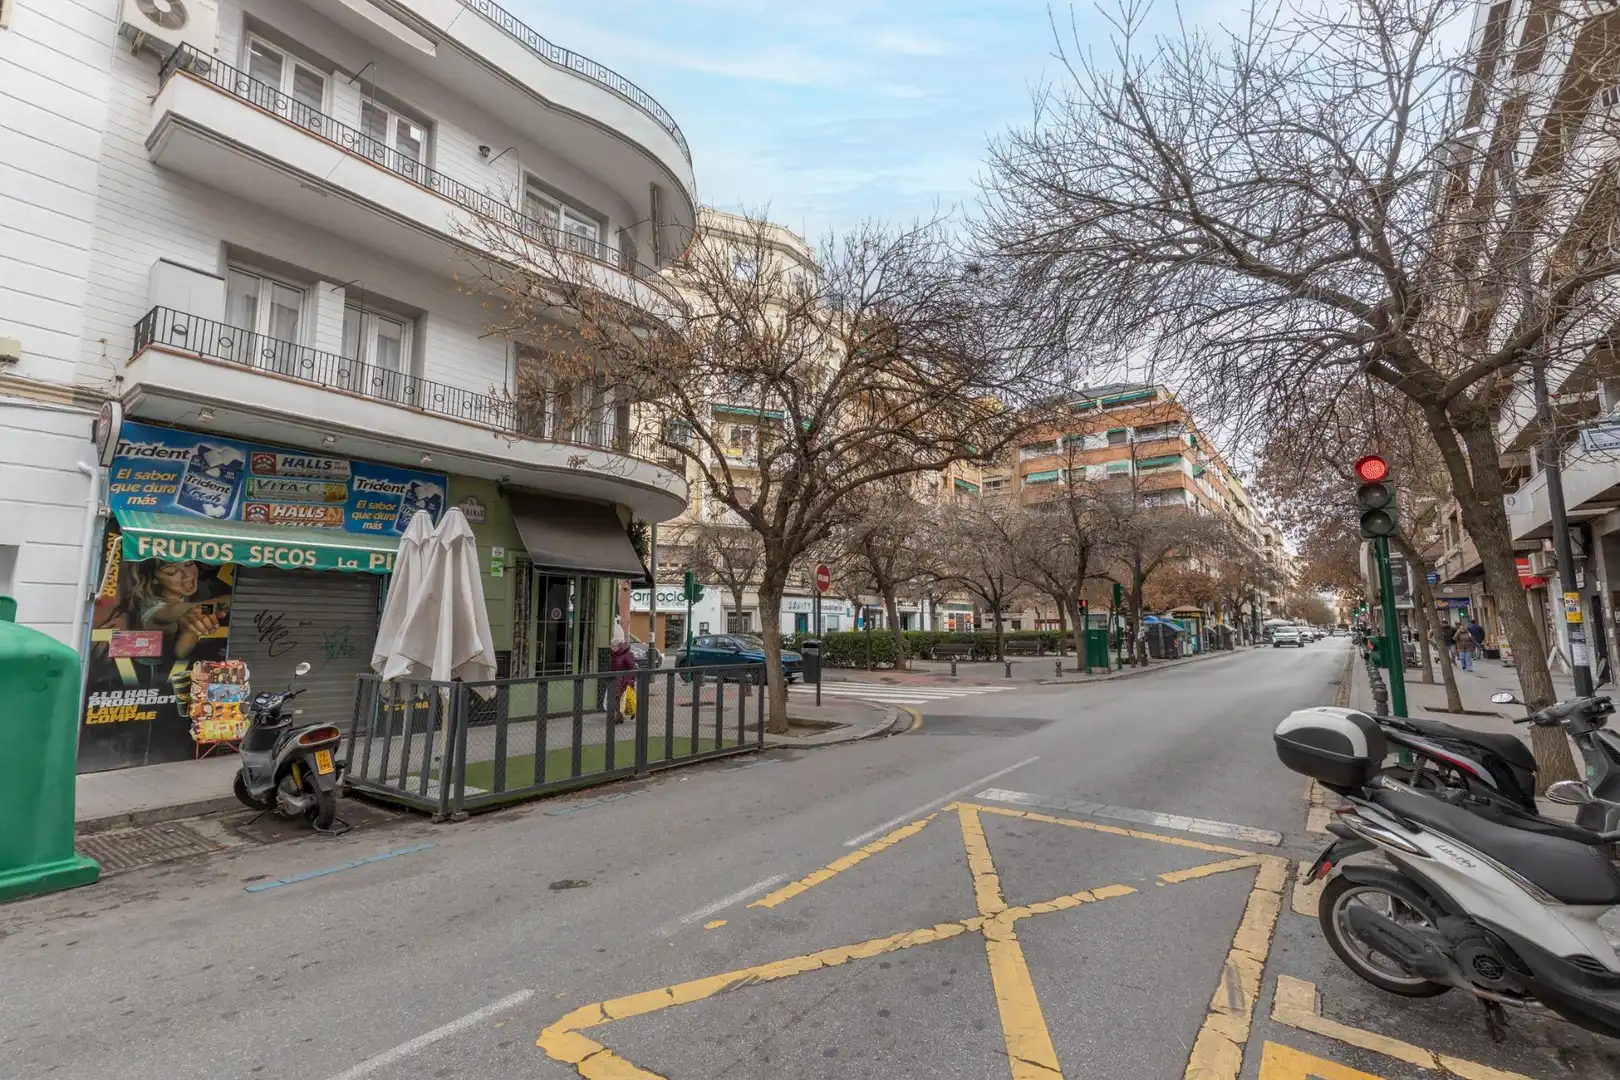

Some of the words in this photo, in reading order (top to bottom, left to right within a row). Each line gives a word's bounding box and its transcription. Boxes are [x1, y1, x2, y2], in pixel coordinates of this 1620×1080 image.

[116, 441, 190, 460] Trident
[281, 457, 332, 470] HALLS
[116, 468, 132, 480] El
[134, 470, 177, 481] sabor
[110, 483, 140, 494] que
[143, 482, 177, 493] dura
[186, 474, 231, 494] Trident
[356, 479, 406, 494] Trident
[127, 494, 158, 505] más
[356, 500, 367, 509] El
[368, 501, 397, 511] sabor
[273, 505, 327, 519] HALLS
[351, 511, 373, 521] que
[373, 511, 398, 521] dura
[362, 521, 384, 530] más
[138, 536, 234, 561] FRUTOS
[249, 545, 317, 567] SECOS
[338, 557, 359, 569] La
[124, 688, 160, 698] HAS
